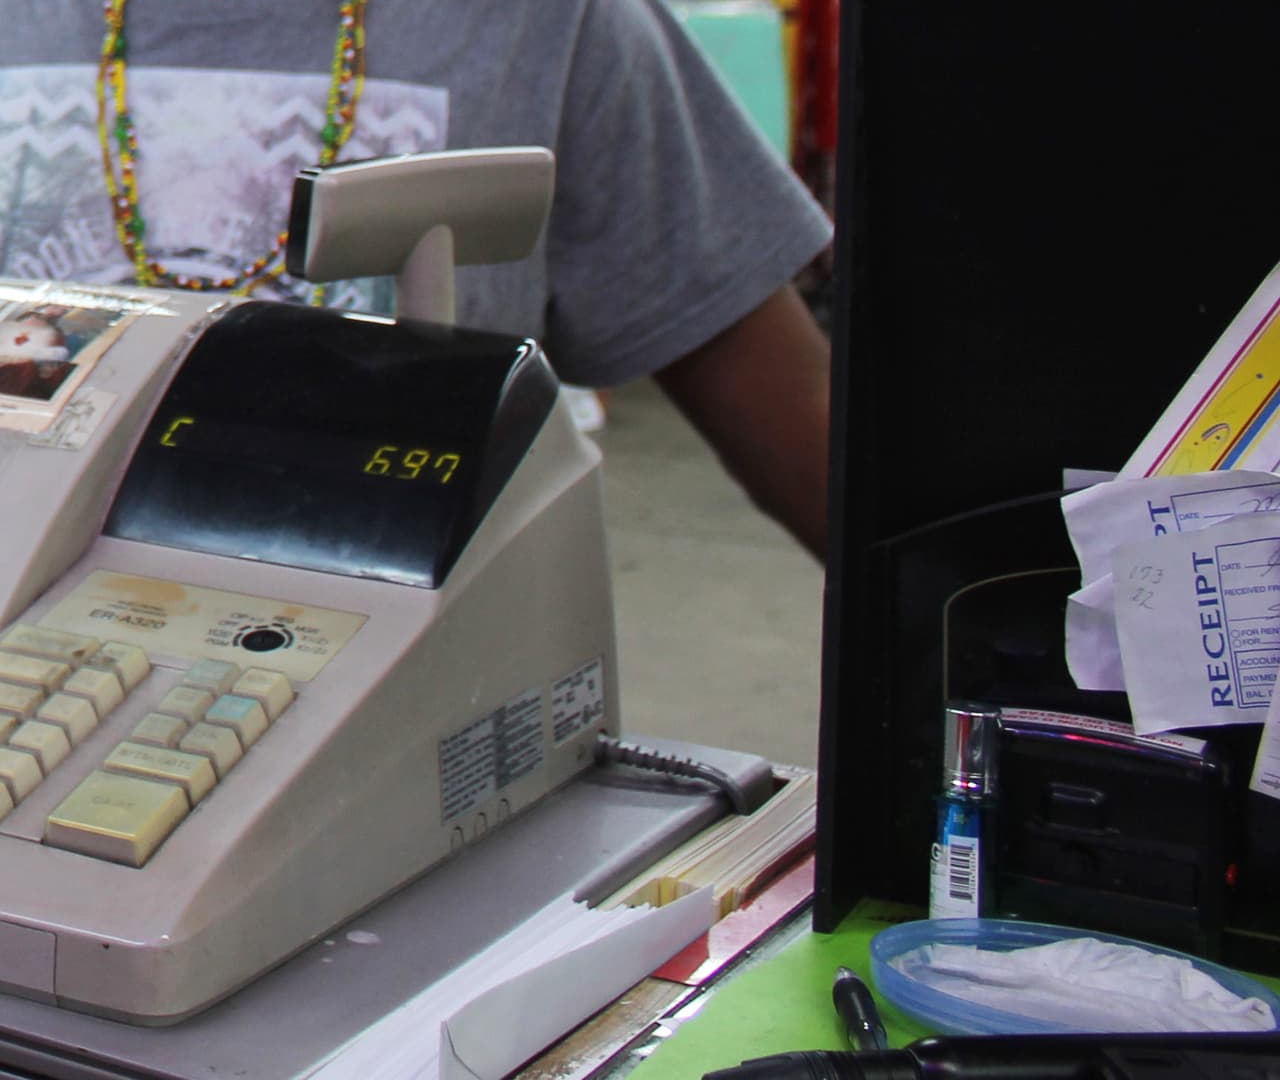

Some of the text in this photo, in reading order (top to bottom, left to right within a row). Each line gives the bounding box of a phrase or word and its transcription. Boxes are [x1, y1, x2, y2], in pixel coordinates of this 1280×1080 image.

[1179, 512, 1200, 520] DATE
[1221, 562, 1241, 571] DATE
[1224, 588, 1264, 596] RECEIVED
[1192, 551, 1234, 708] RECEIPT
[1242, 628, 1258, 636] FOR
